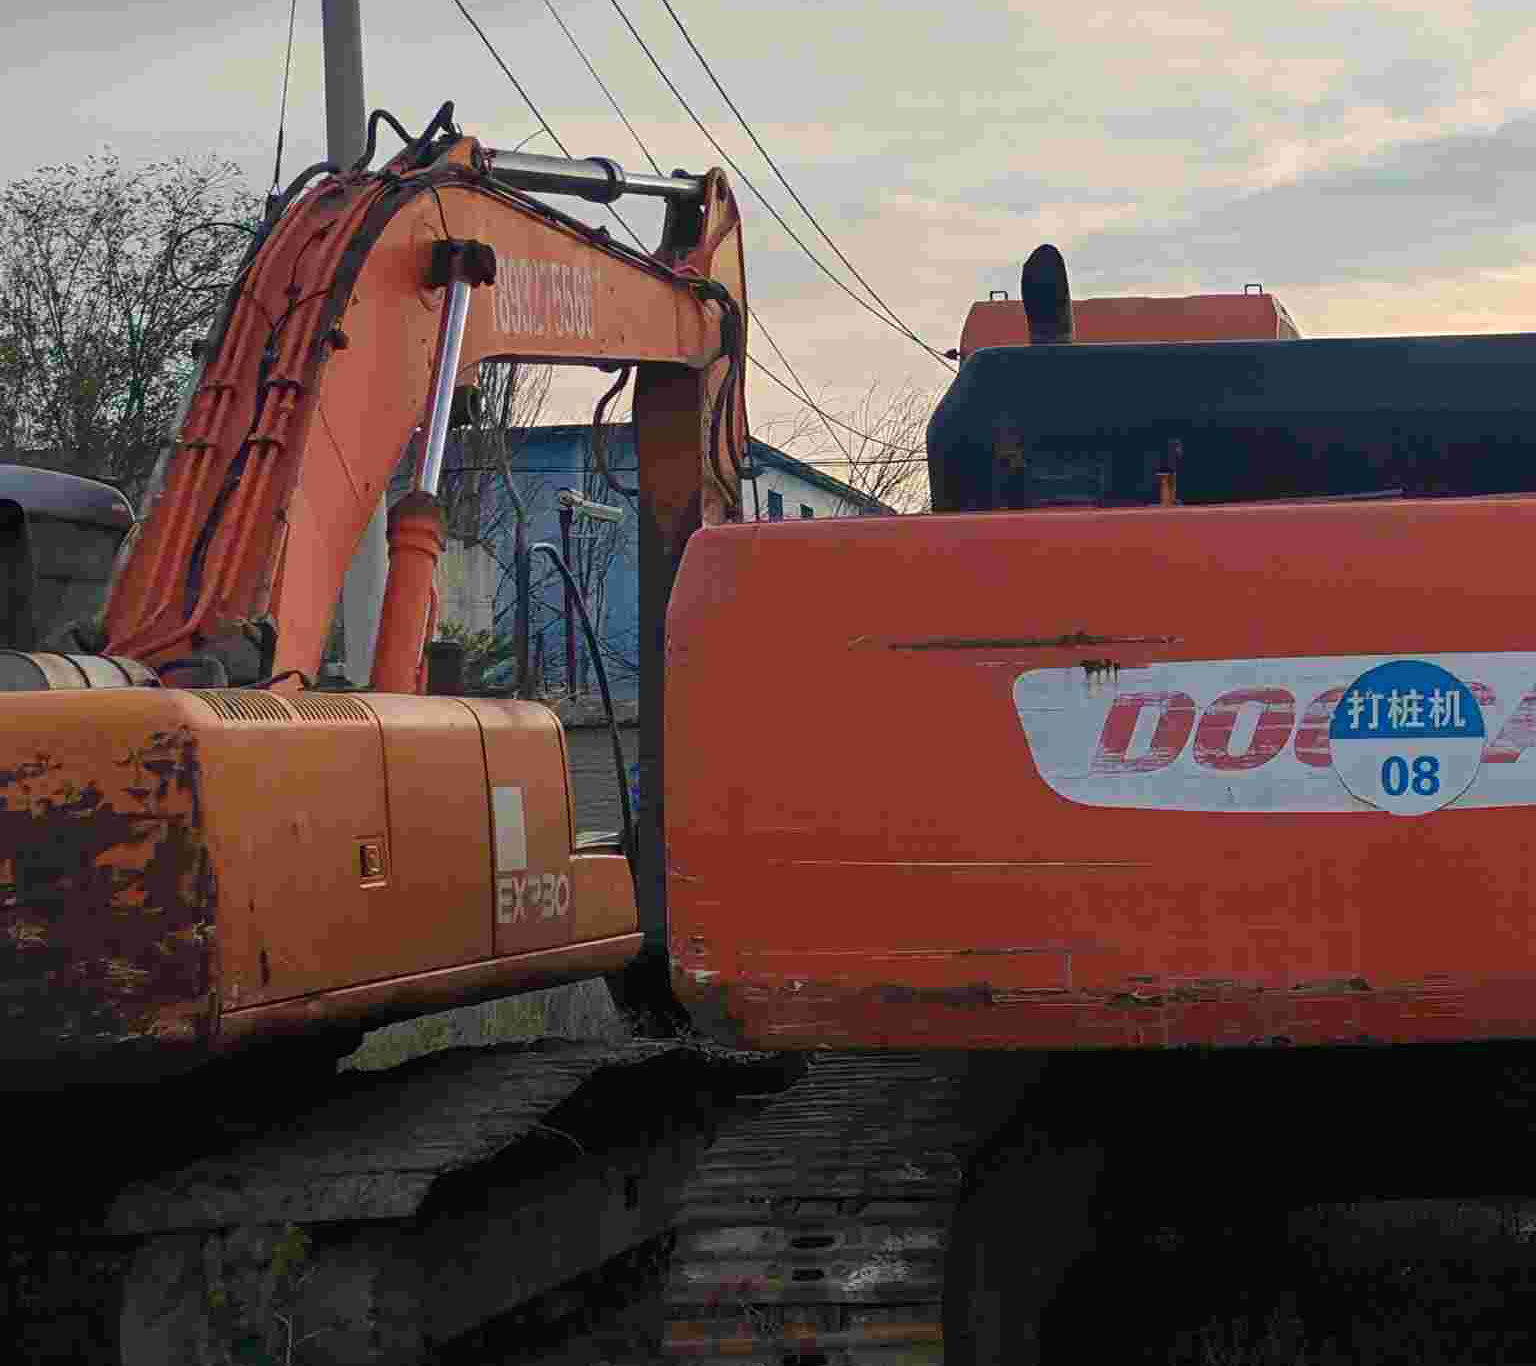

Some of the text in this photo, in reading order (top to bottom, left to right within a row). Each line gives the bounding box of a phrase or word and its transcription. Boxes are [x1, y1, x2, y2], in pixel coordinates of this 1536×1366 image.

[1347, 688, 1466, 730] 打桩机
[1381, 755, 1441, 796] 08
